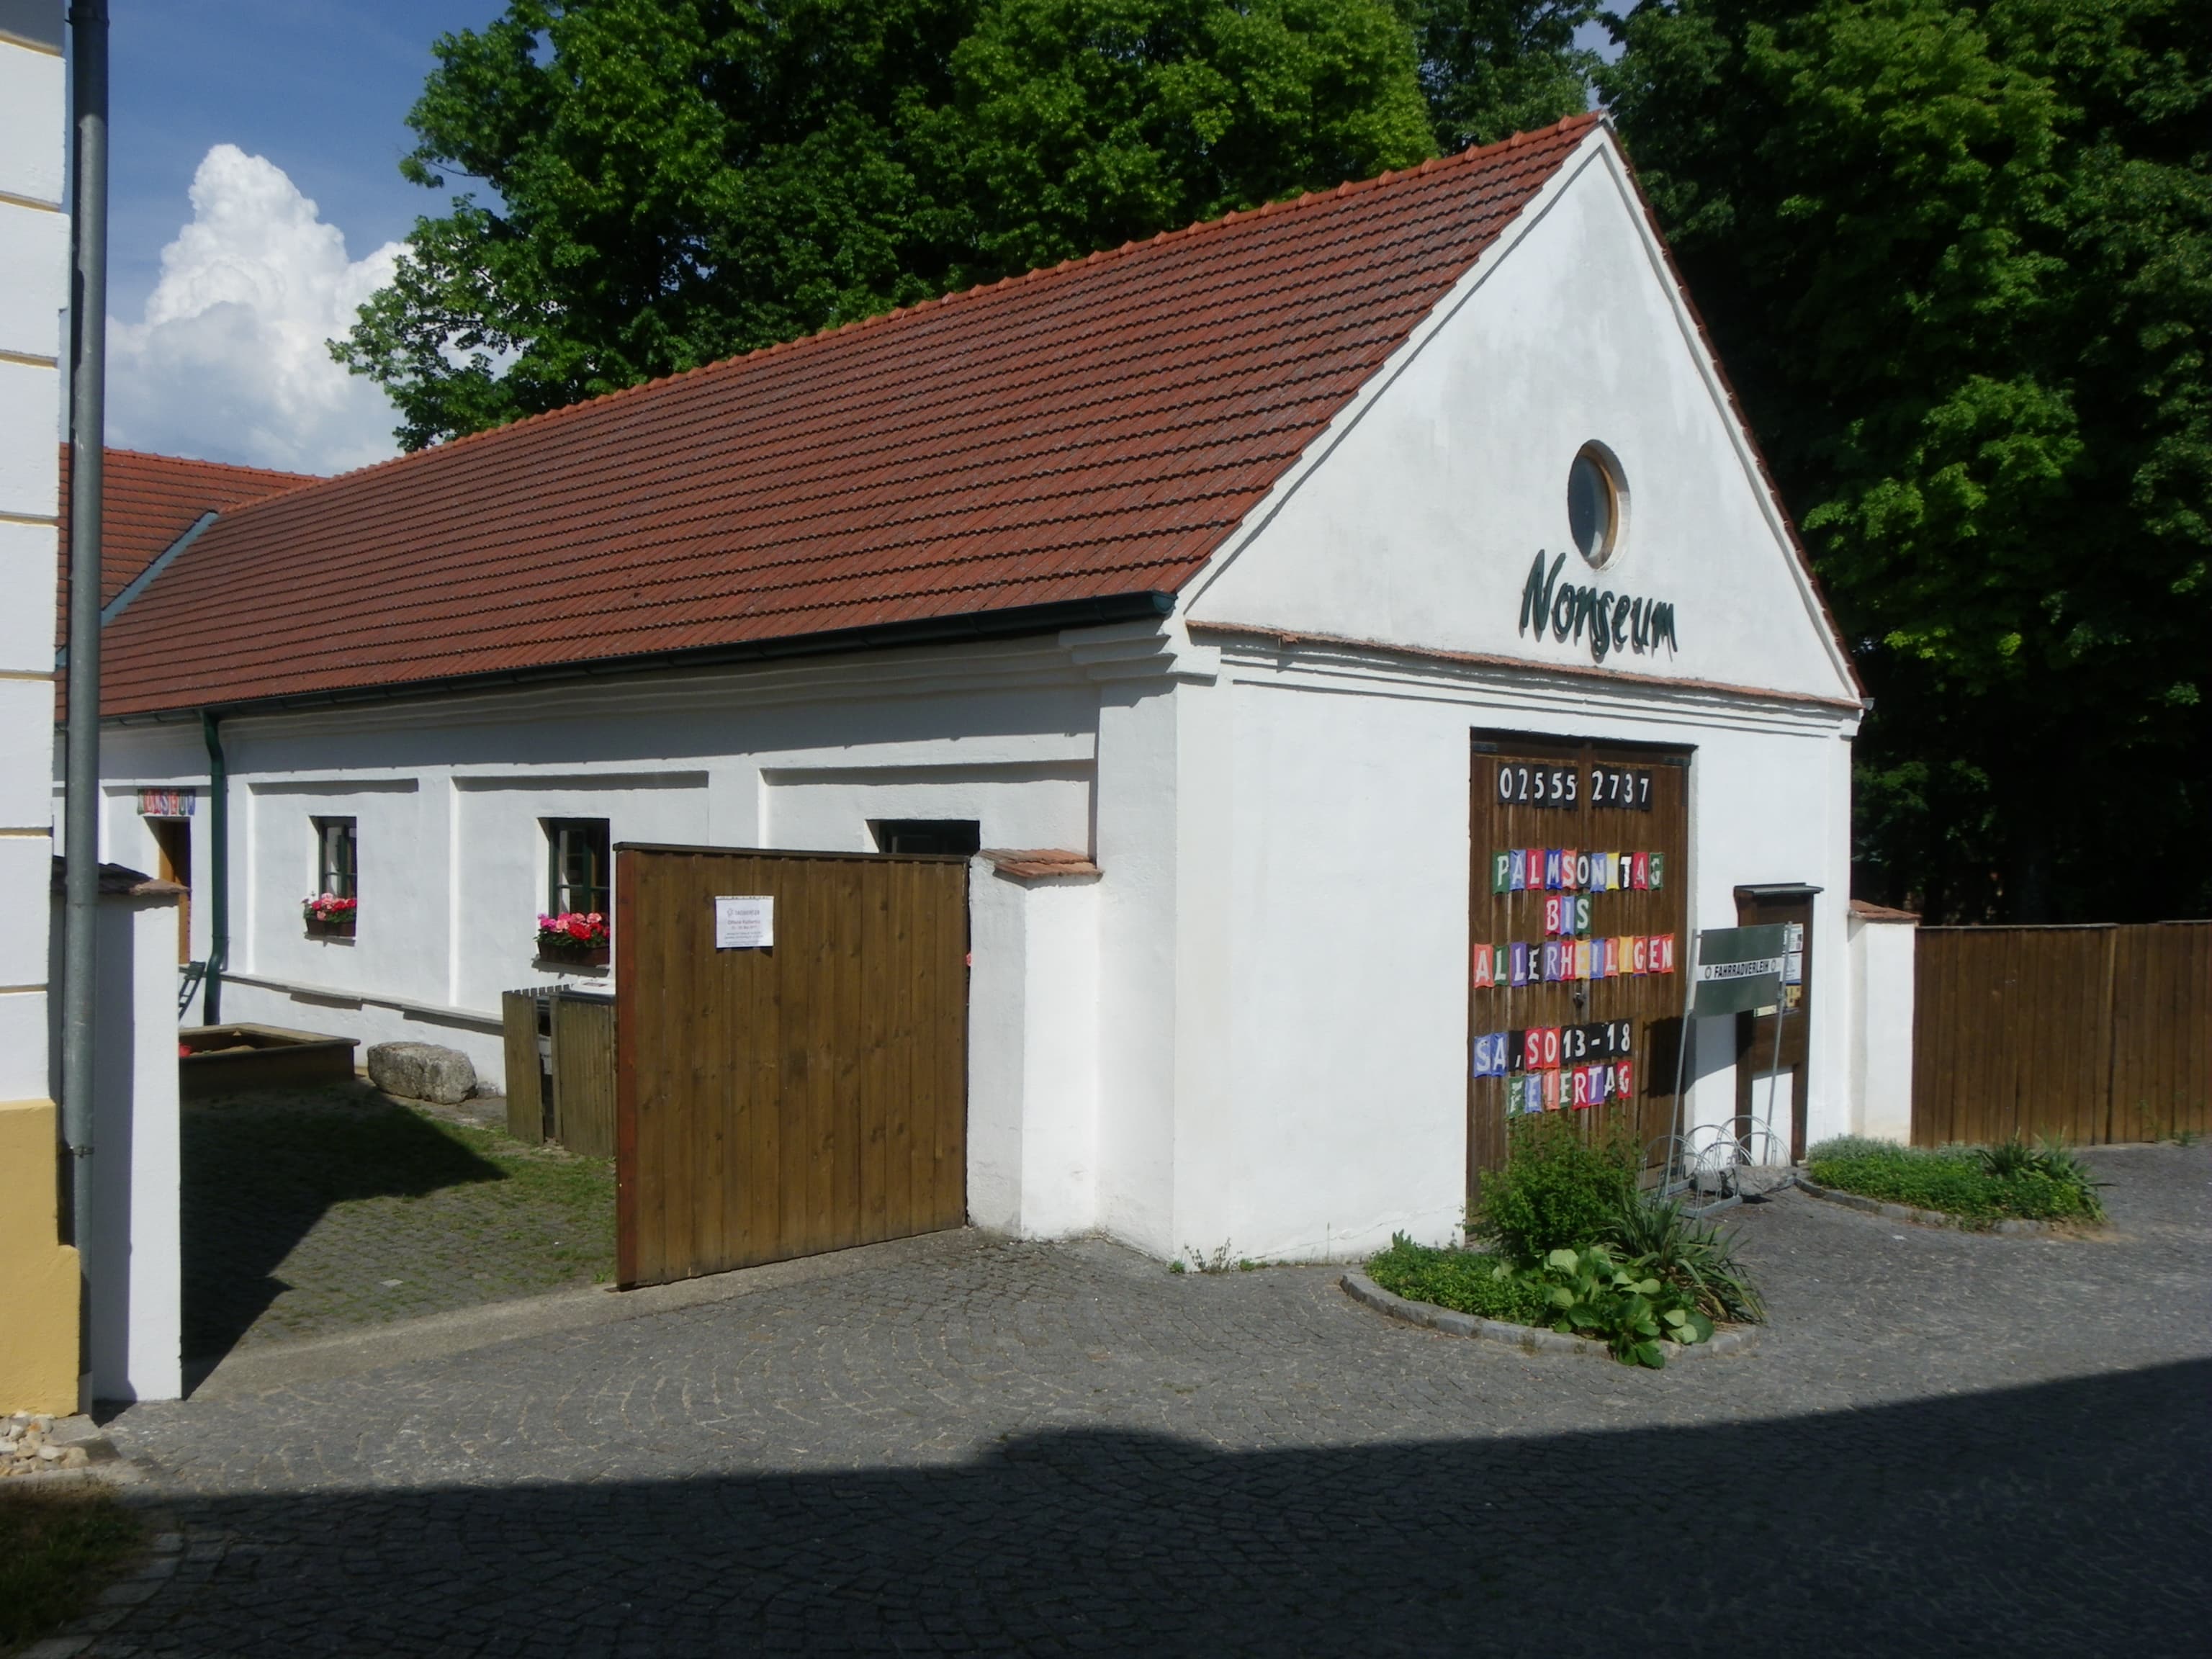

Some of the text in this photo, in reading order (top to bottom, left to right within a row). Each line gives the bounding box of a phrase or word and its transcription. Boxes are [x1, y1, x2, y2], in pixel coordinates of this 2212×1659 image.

[1519, 549, 1678, 656] Nonseum
[1499, 768, 1650, 804] 02555 2737
[1496, 854, 1660, 887] PALMSONNTAG
[1546, 898, 1589, 931] BIS
[1475, 937, 1673, 984] ALLERHEILIGEN
[1714, 960, 1770, 979] FAHRRADVERLEIH
[1509, 1064, 1629, 1113] FEIERTAG
